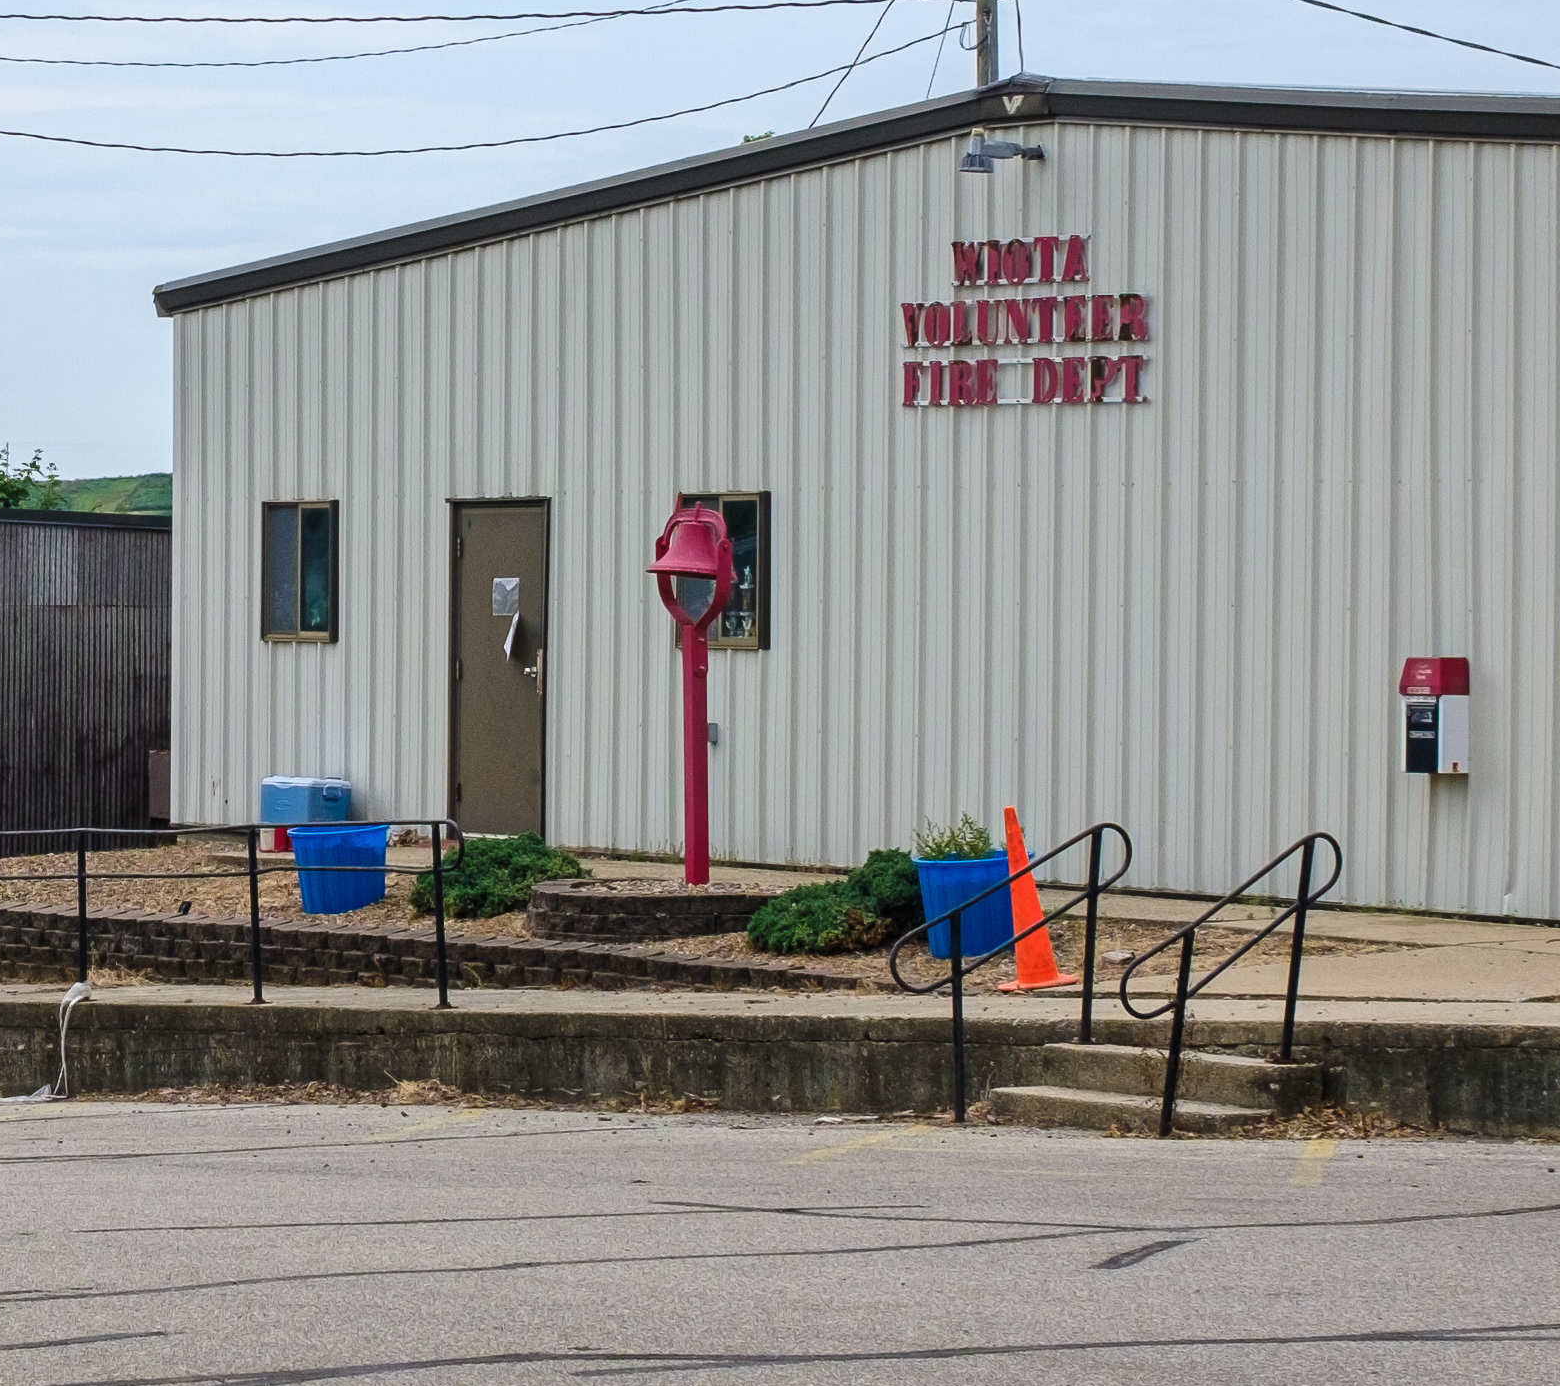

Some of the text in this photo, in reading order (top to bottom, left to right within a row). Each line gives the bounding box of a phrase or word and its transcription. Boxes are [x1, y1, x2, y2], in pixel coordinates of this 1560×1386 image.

[951, 234, 1090, 286] WIOTA
[901, 293, 1148, 347] VOLUNTEER
[903, 355, 1146, 406] FIRE DEPT
